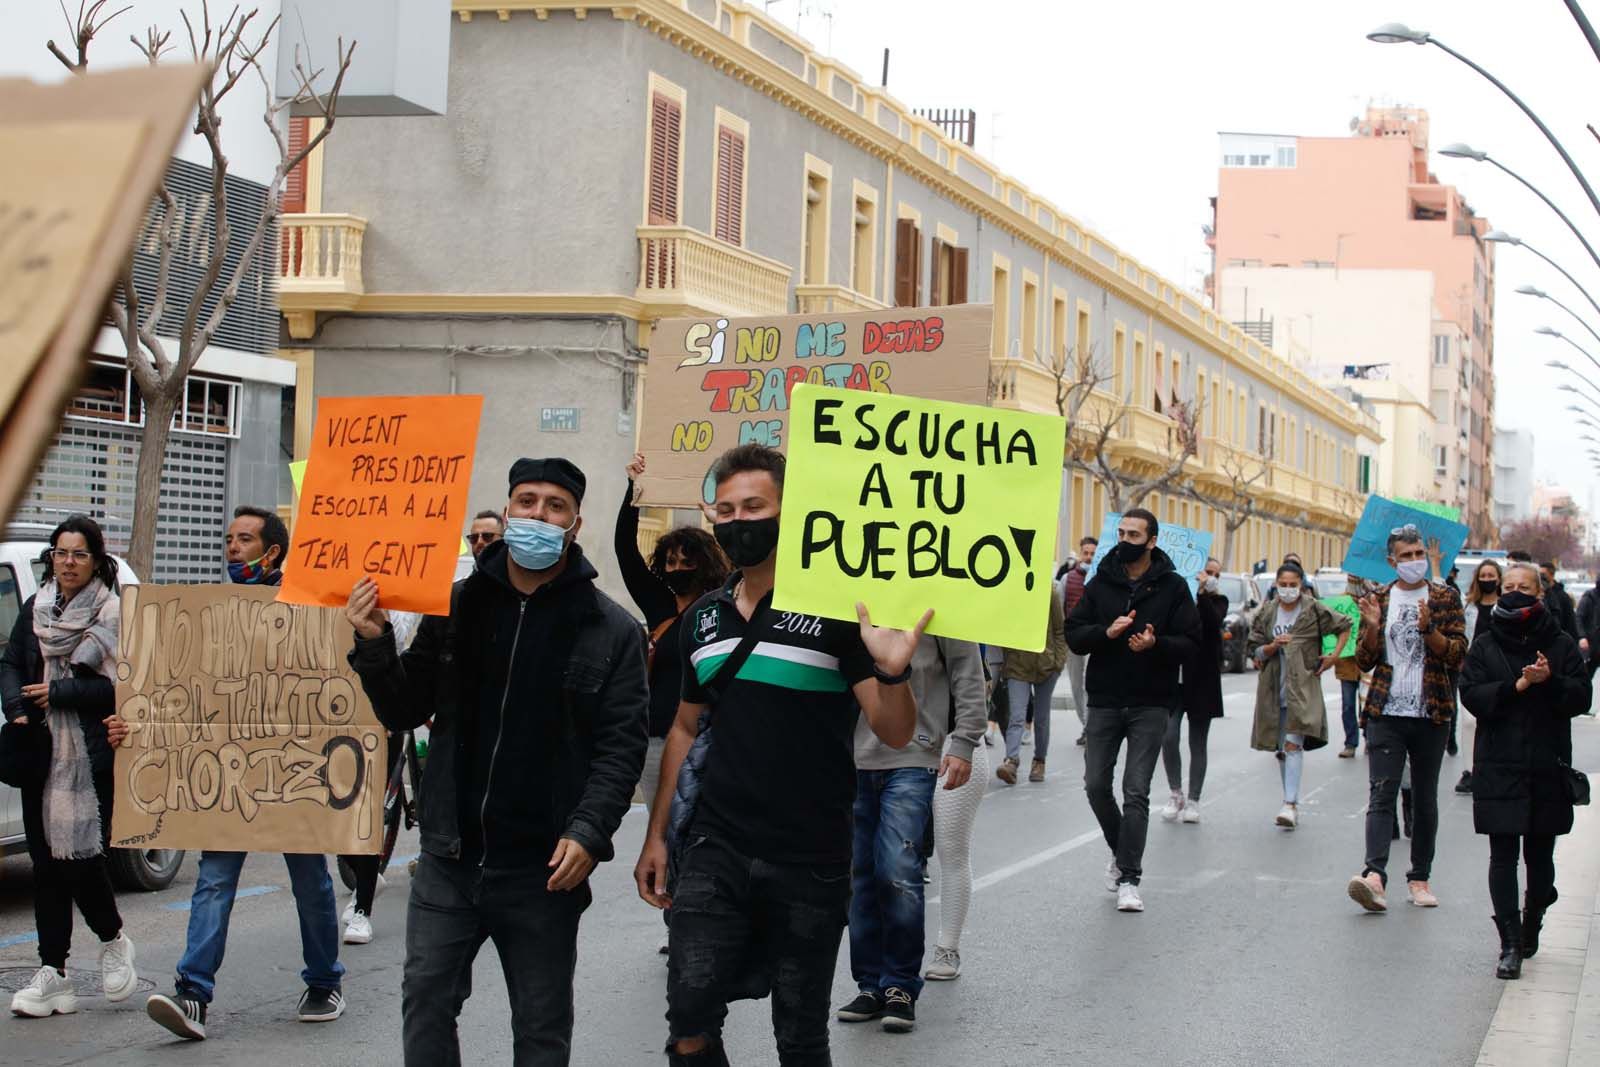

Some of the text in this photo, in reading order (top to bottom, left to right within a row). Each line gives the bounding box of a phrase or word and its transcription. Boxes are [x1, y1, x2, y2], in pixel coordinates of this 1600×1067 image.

[676, 317, 944, 372] Si NO ME DEJAS
[328, 414, 408, 447] VICENT
[671, 419, 783, 452] NO ME
[814, 399, 1038, 466] ESCUCHA
[351, 455, 466, 485] PRESIDENT
[859, 463, 965, 515] A TU
[311, 494, 448, 520] ESCOLTA A LA
[298, 538, 437, 579] TEVA GENT
[801, 510, 1036, 592] PUEBLO!
[200, 593, 262, 679] HAY
[260, 601, 337, 671] PAN
[773, 612, 822, 637] 20th
[119, 672, 356, 749] PARA TANTO
